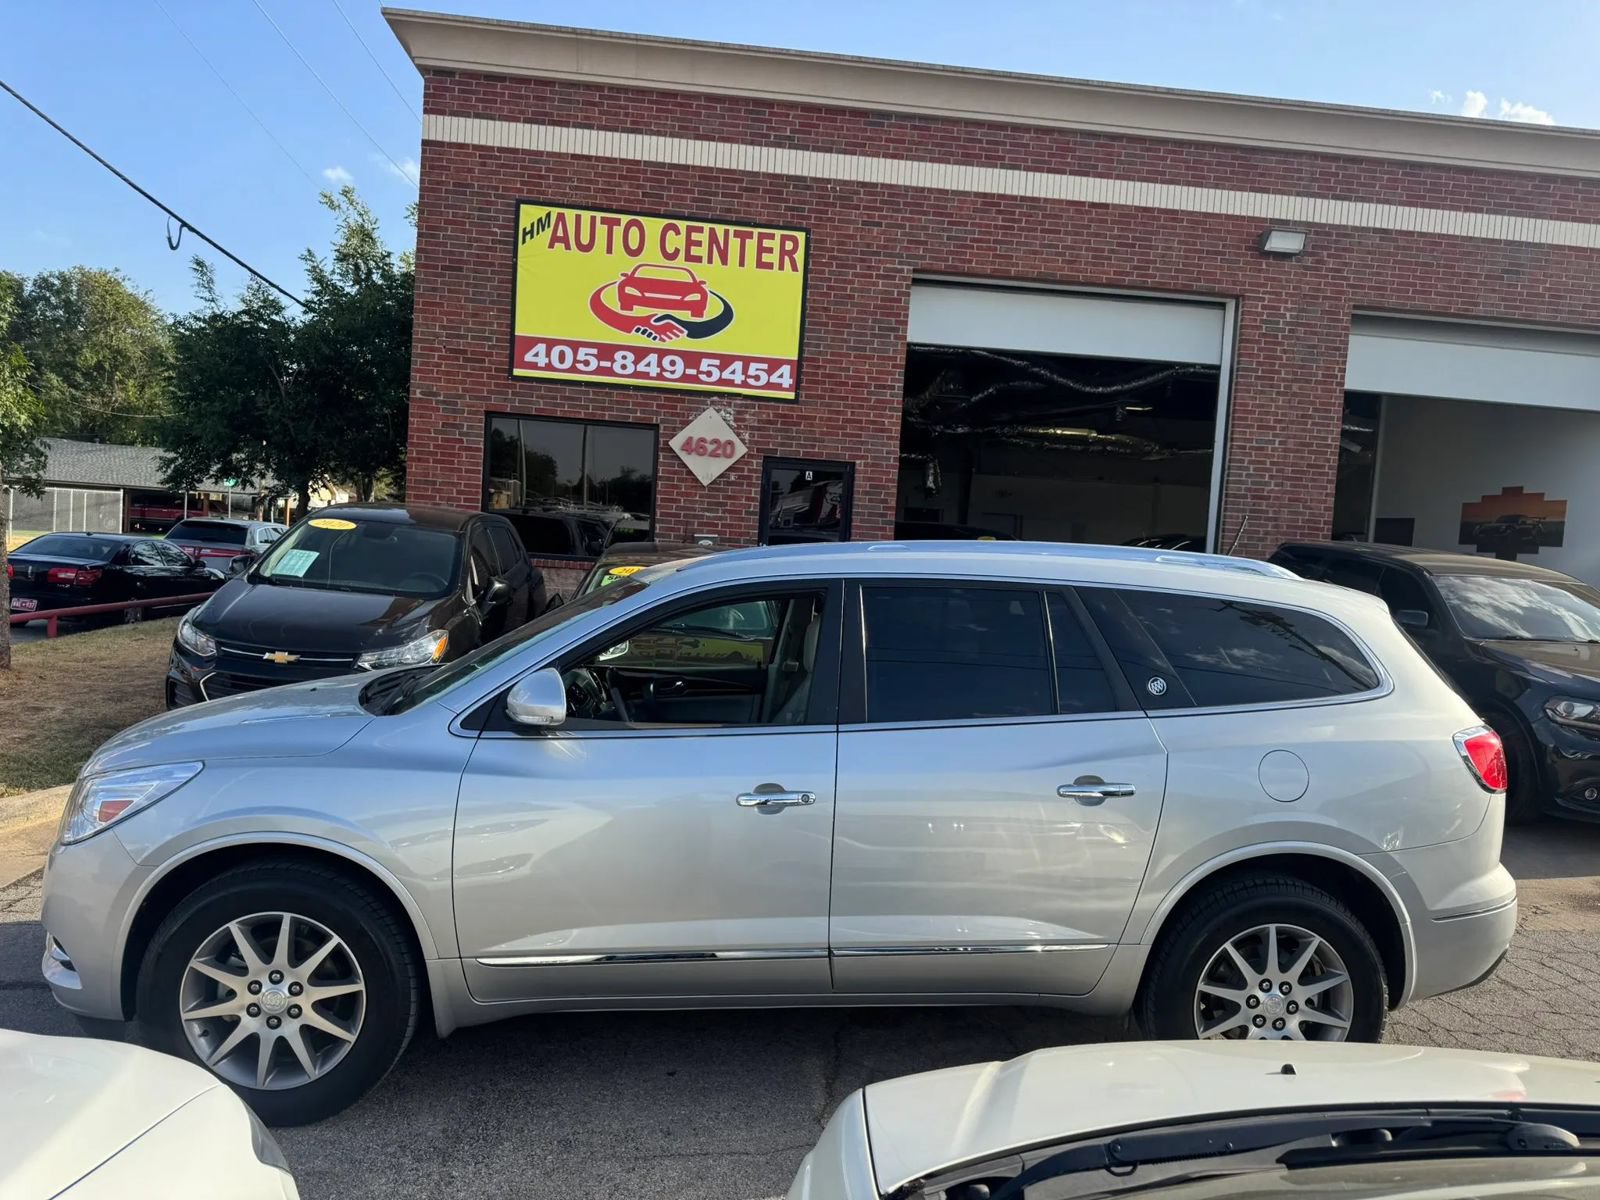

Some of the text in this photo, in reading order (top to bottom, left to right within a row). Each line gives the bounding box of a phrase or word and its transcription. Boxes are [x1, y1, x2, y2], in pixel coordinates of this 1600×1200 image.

[521, 211, 800, 272] HM AUTO CENTER
[524, 343, 793, 388] 405-849-5454
[680, 436, 736, 459] 4620
